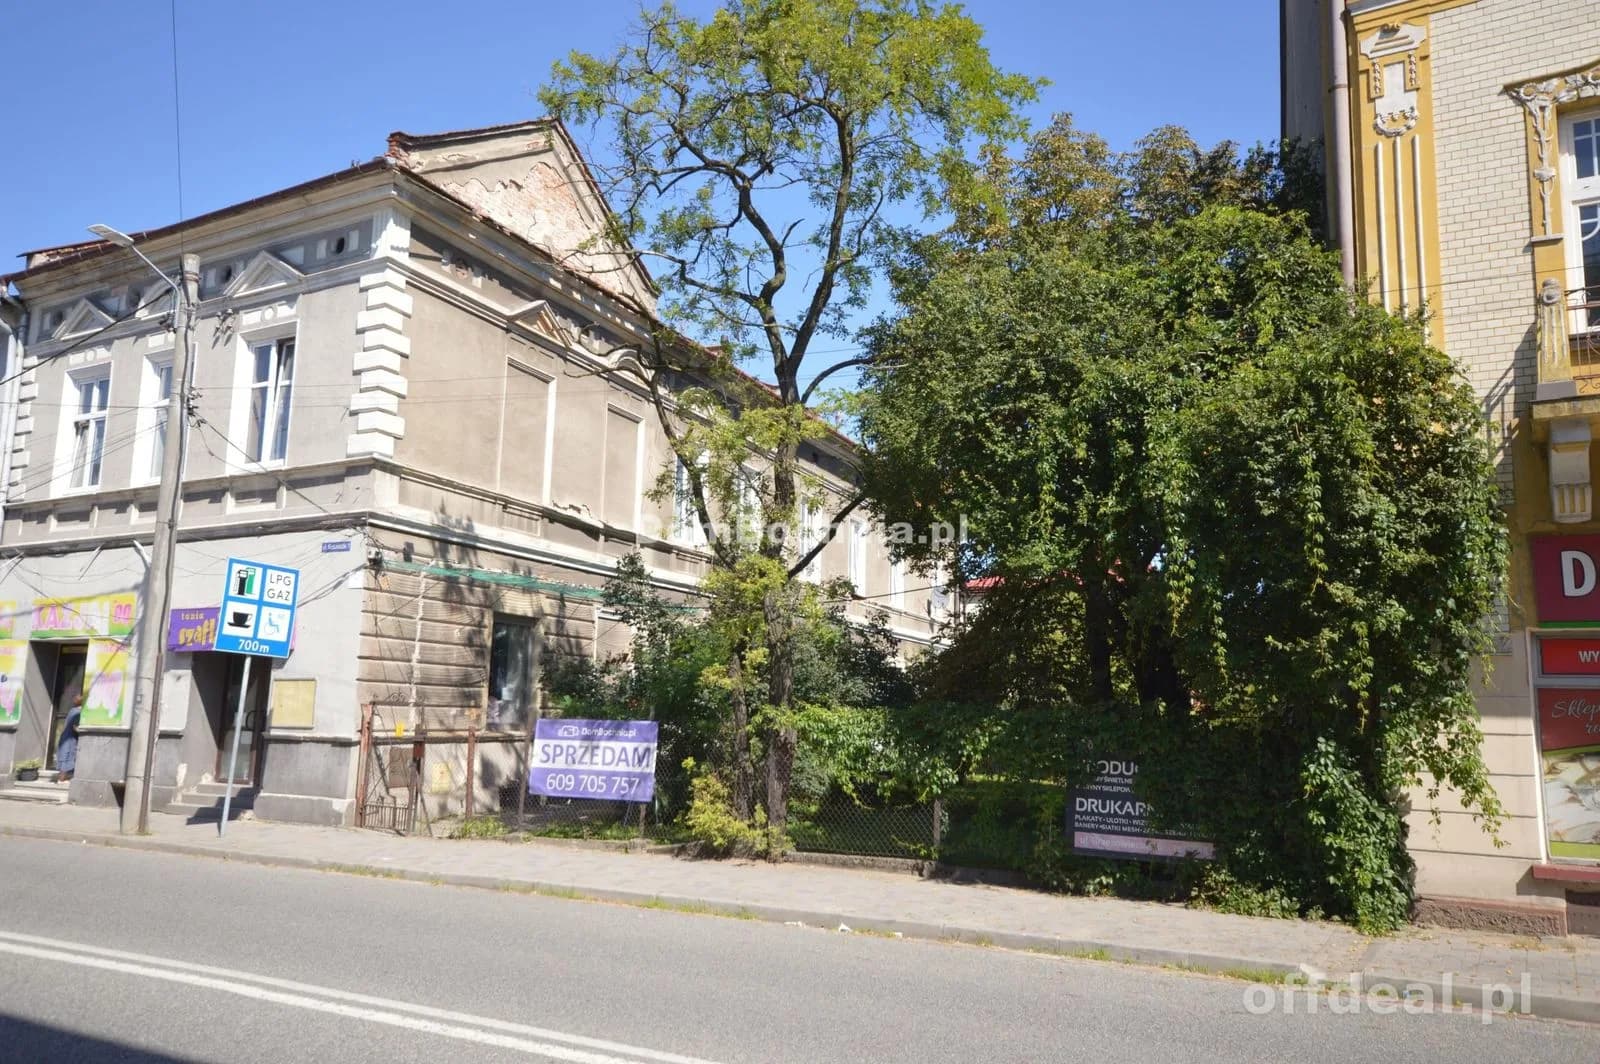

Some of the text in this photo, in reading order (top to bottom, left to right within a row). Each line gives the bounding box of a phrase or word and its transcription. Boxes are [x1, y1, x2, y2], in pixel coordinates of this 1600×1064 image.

[269, 573, 292, 586] LPG
[266, 588, 291, 601] GAZ
[539, 743, 651, 769] SPRZEDAM
[546, 773, 640, 795] 609 705 757
[1074, 815, 1102, 823] PLAKATY
